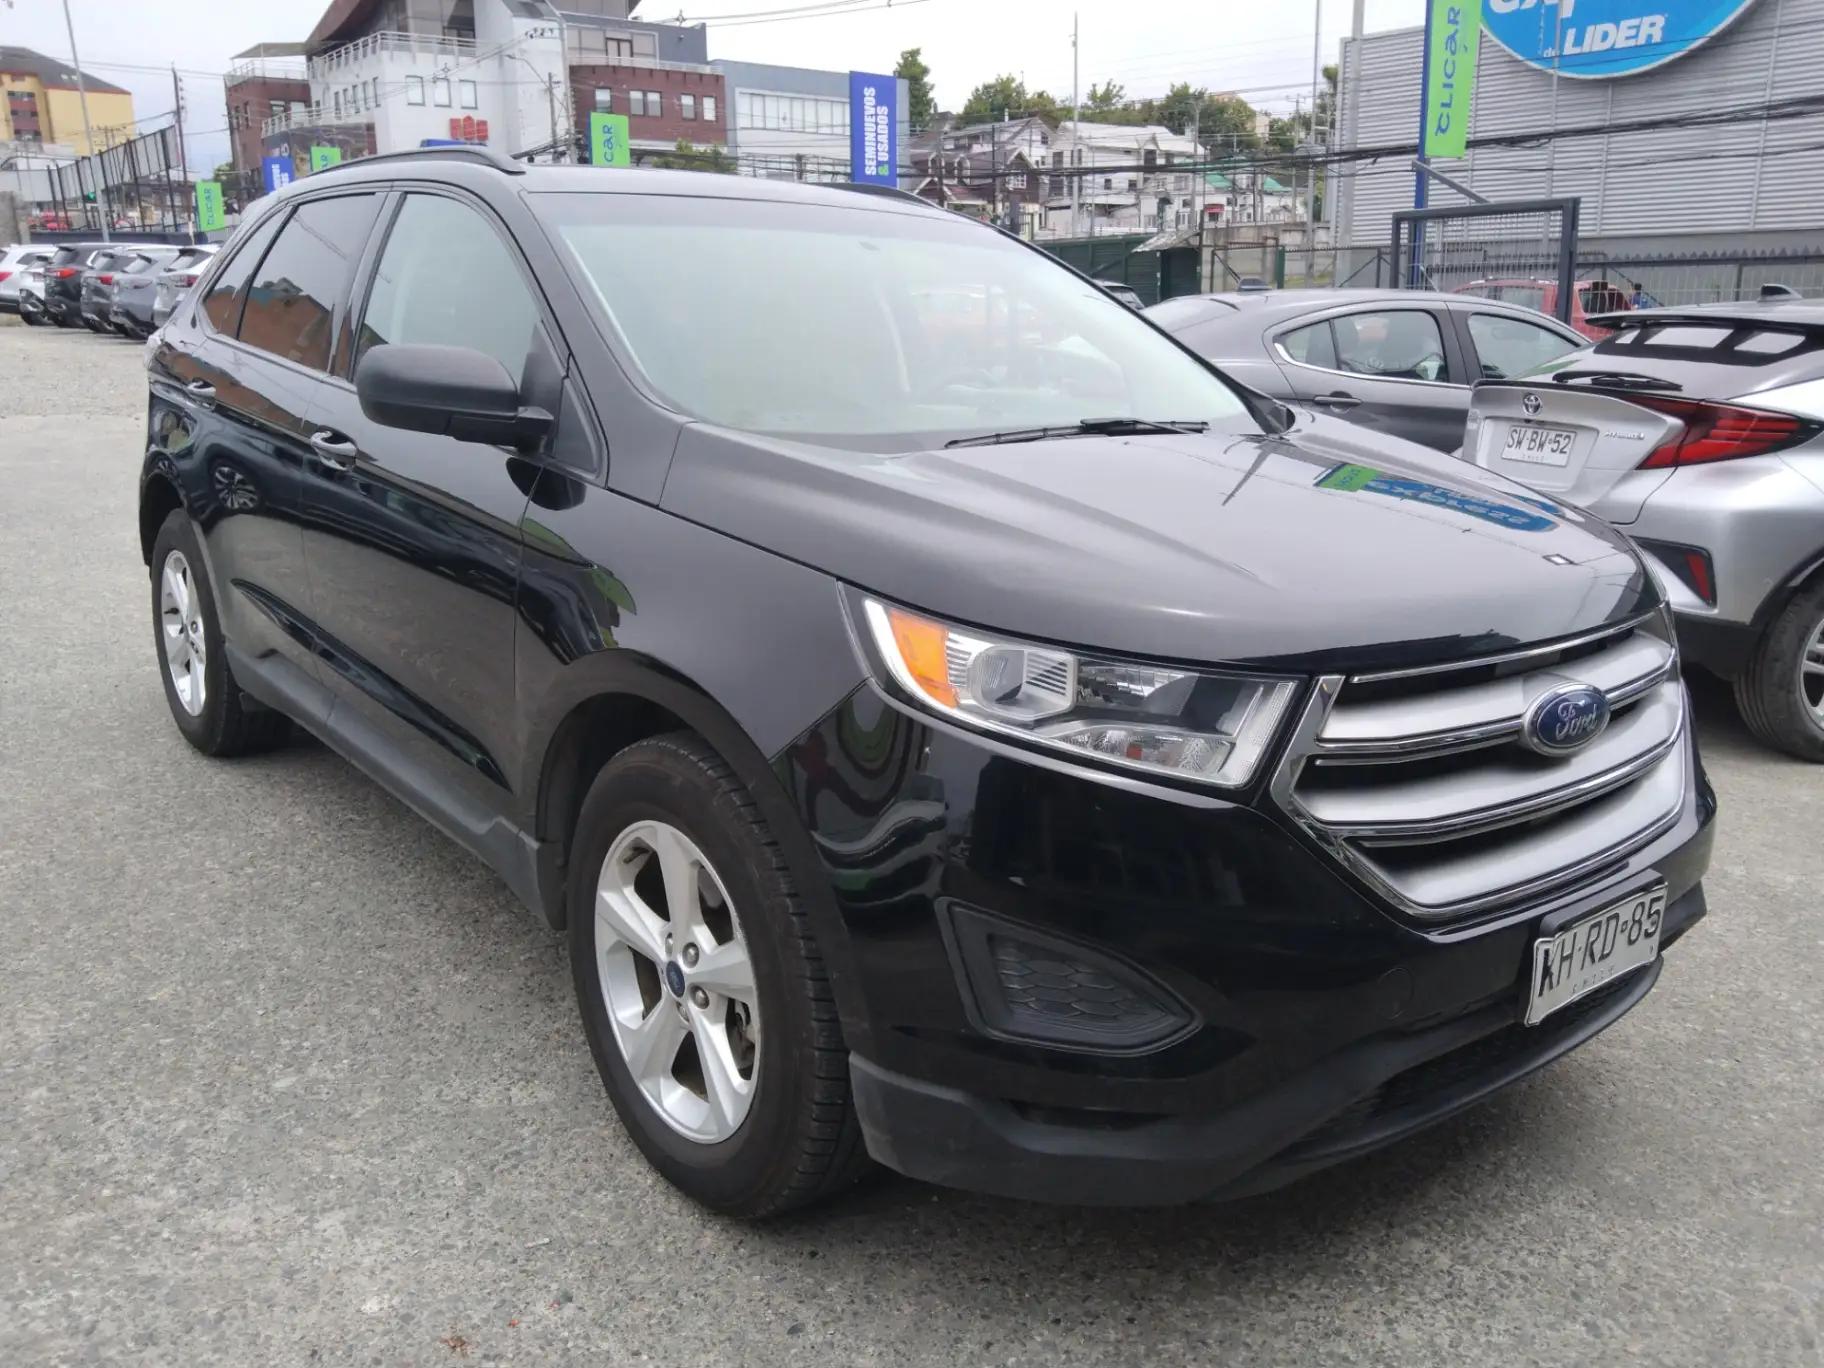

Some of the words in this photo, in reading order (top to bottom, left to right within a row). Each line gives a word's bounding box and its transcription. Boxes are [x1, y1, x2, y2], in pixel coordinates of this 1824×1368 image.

[1563, 14, 1666, 56] LIDER
[863, 86, 877, 176] SEMINUEVOS
[876, 105, 889, 162] USADOS
[1555, 699, 1598, 741] Ford
